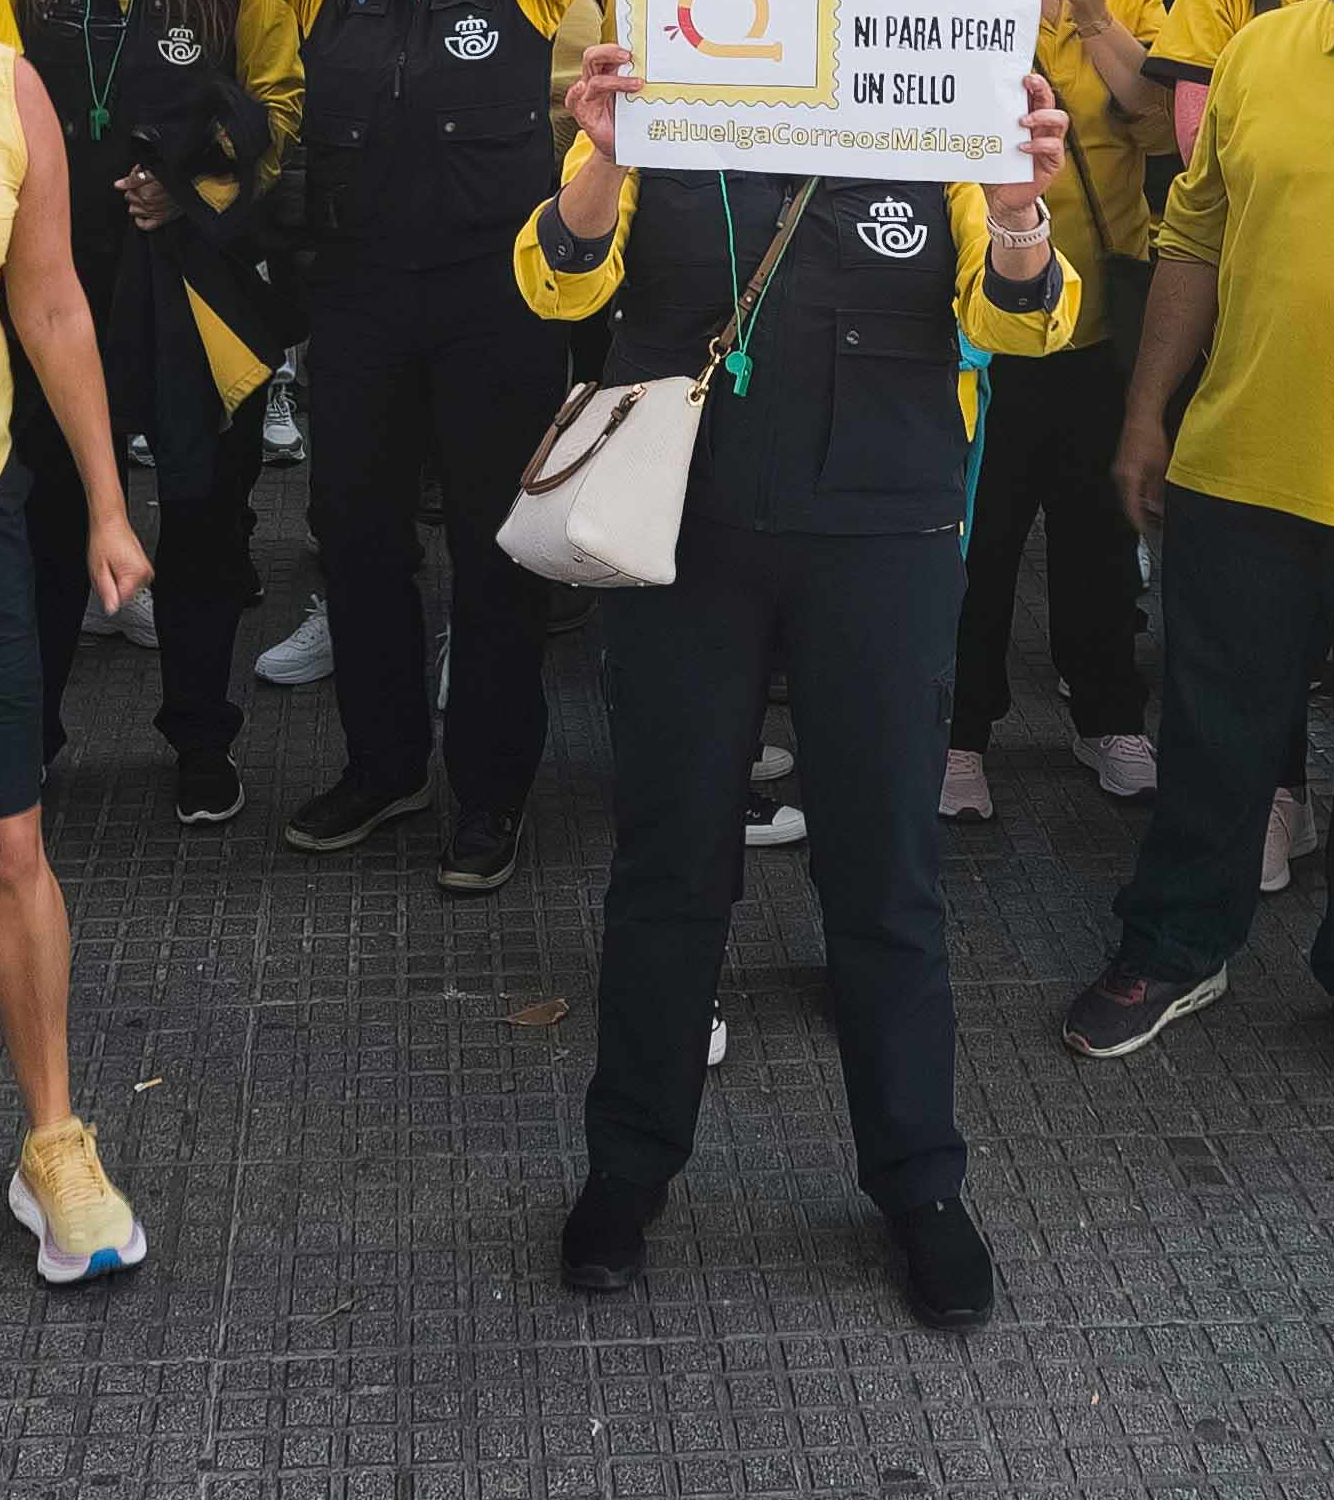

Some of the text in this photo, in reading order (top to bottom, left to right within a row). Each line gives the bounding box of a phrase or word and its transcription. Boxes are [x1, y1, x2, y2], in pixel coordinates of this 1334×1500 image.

[854, 16, 1016, 53] NI PARA PEGAR
[854, 72, 956, 105] UN SELLO
[648, 119, 1004, 160] #HuelgaCorreosMálaga
